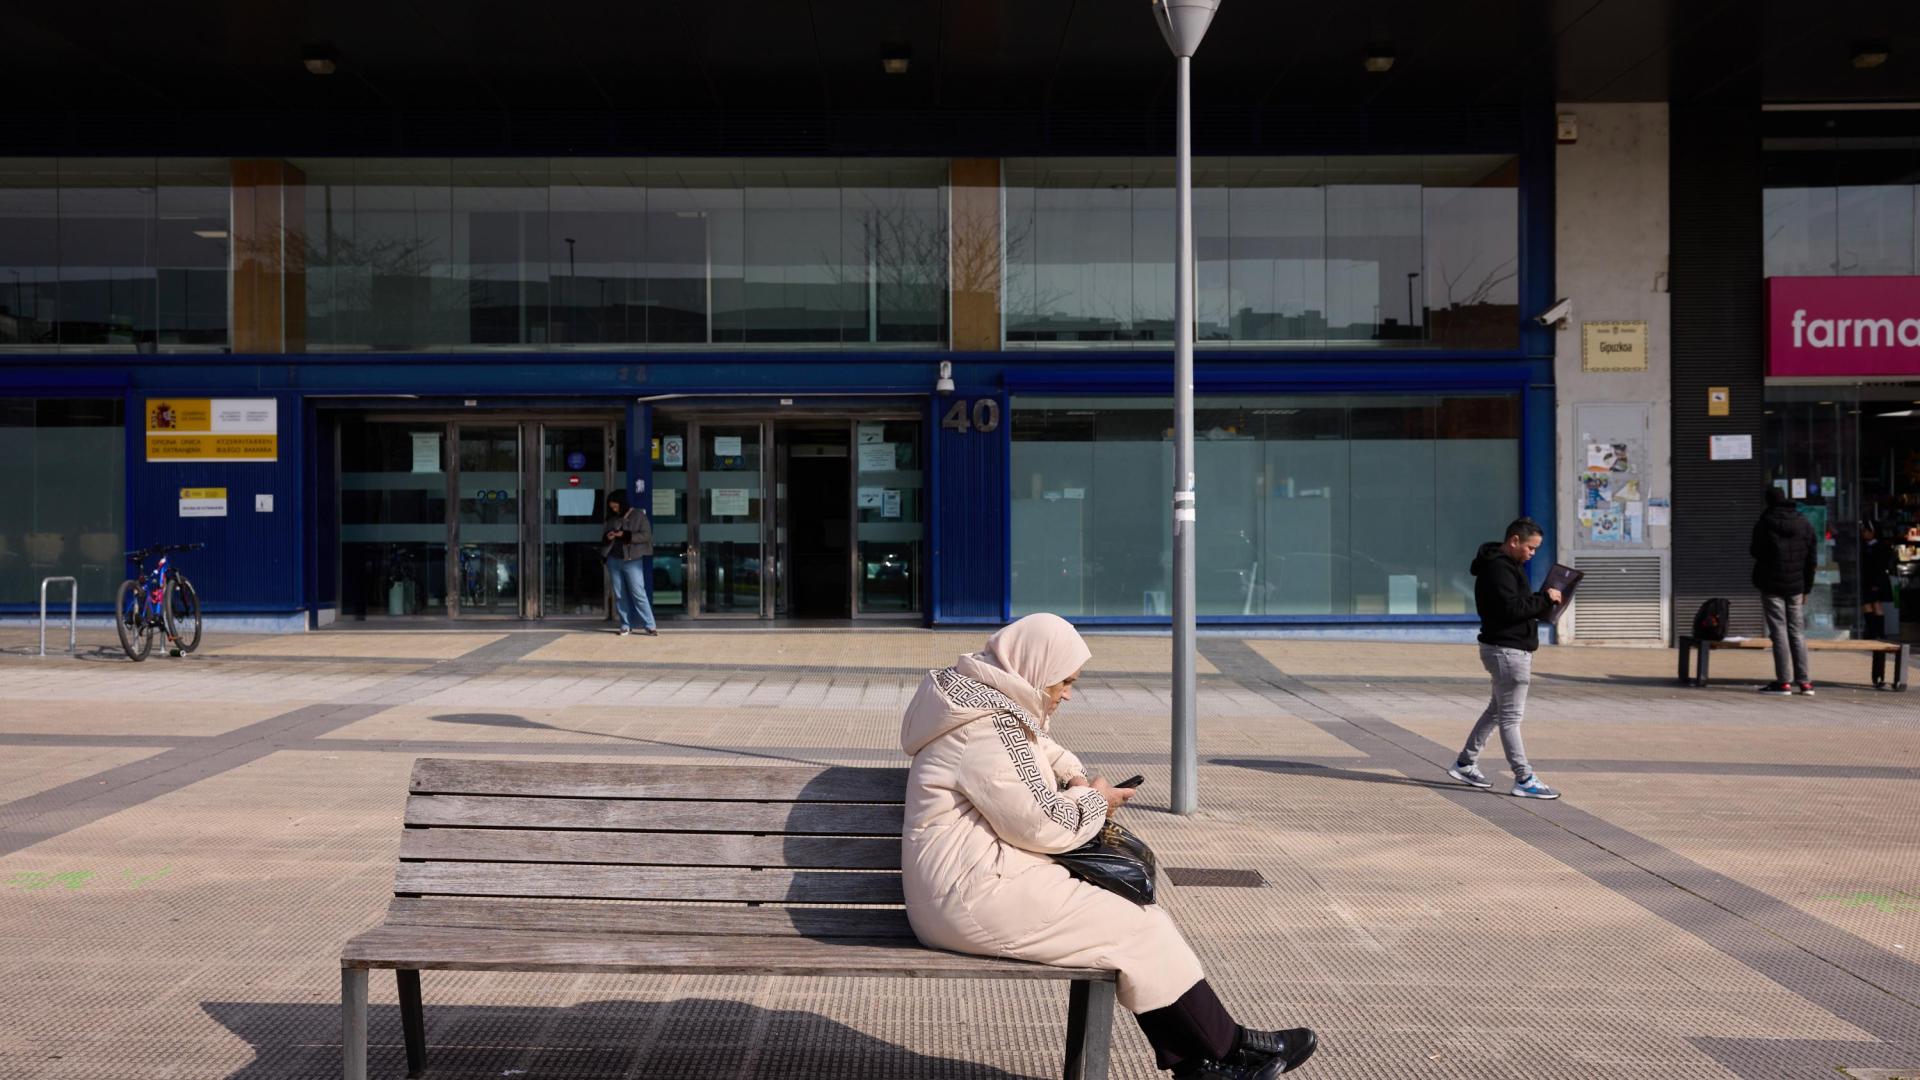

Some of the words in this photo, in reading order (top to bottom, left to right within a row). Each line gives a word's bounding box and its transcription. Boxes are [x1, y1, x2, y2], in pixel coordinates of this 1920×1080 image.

[1791, 309, 1920, 348] farma
[1600, 341, 1632, 354] Gipuzkoa
[942, 398, 999, 433] 40
